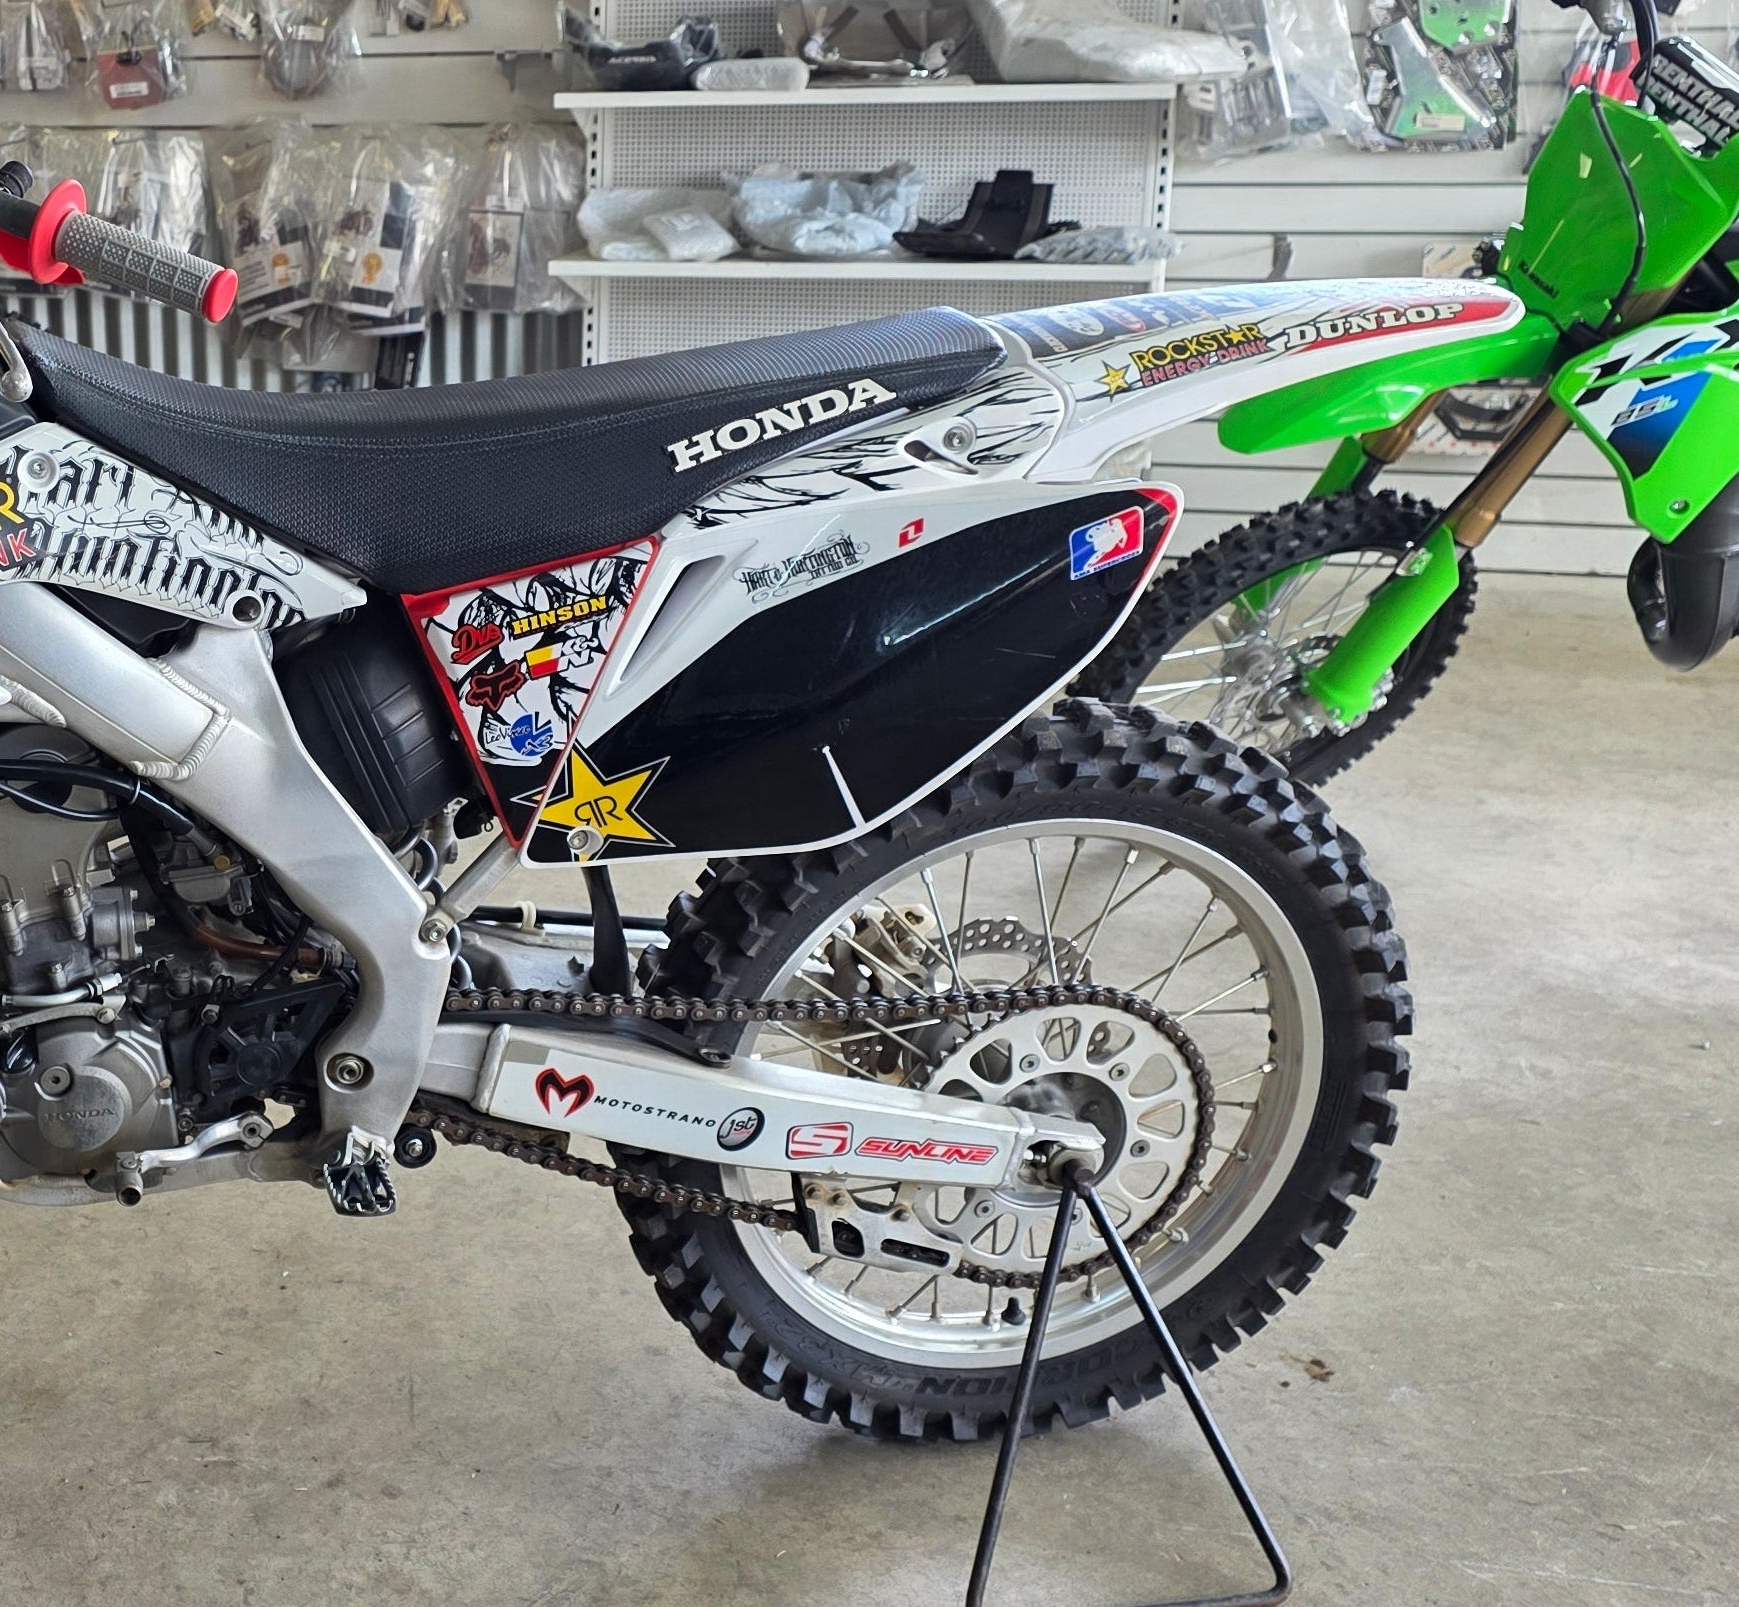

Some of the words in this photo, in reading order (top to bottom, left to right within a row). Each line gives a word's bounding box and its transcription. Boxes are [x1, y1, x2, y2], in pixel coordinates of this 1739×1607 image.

[1283, 302, 1464, 349] DUNLOP
[1141, 357, 1211, 389] ENERGY
[1215, 338, 1271, 366] DRINK
[668, 378, 897, 473] HONDA
[512, 595, 608, 636] HINSON
[45, 1107, 116, 1122] HONDA
[593, 1095, 717, 1129] MOTOSTRANO
[857, 1138, 998, 1164] SUNLINE
